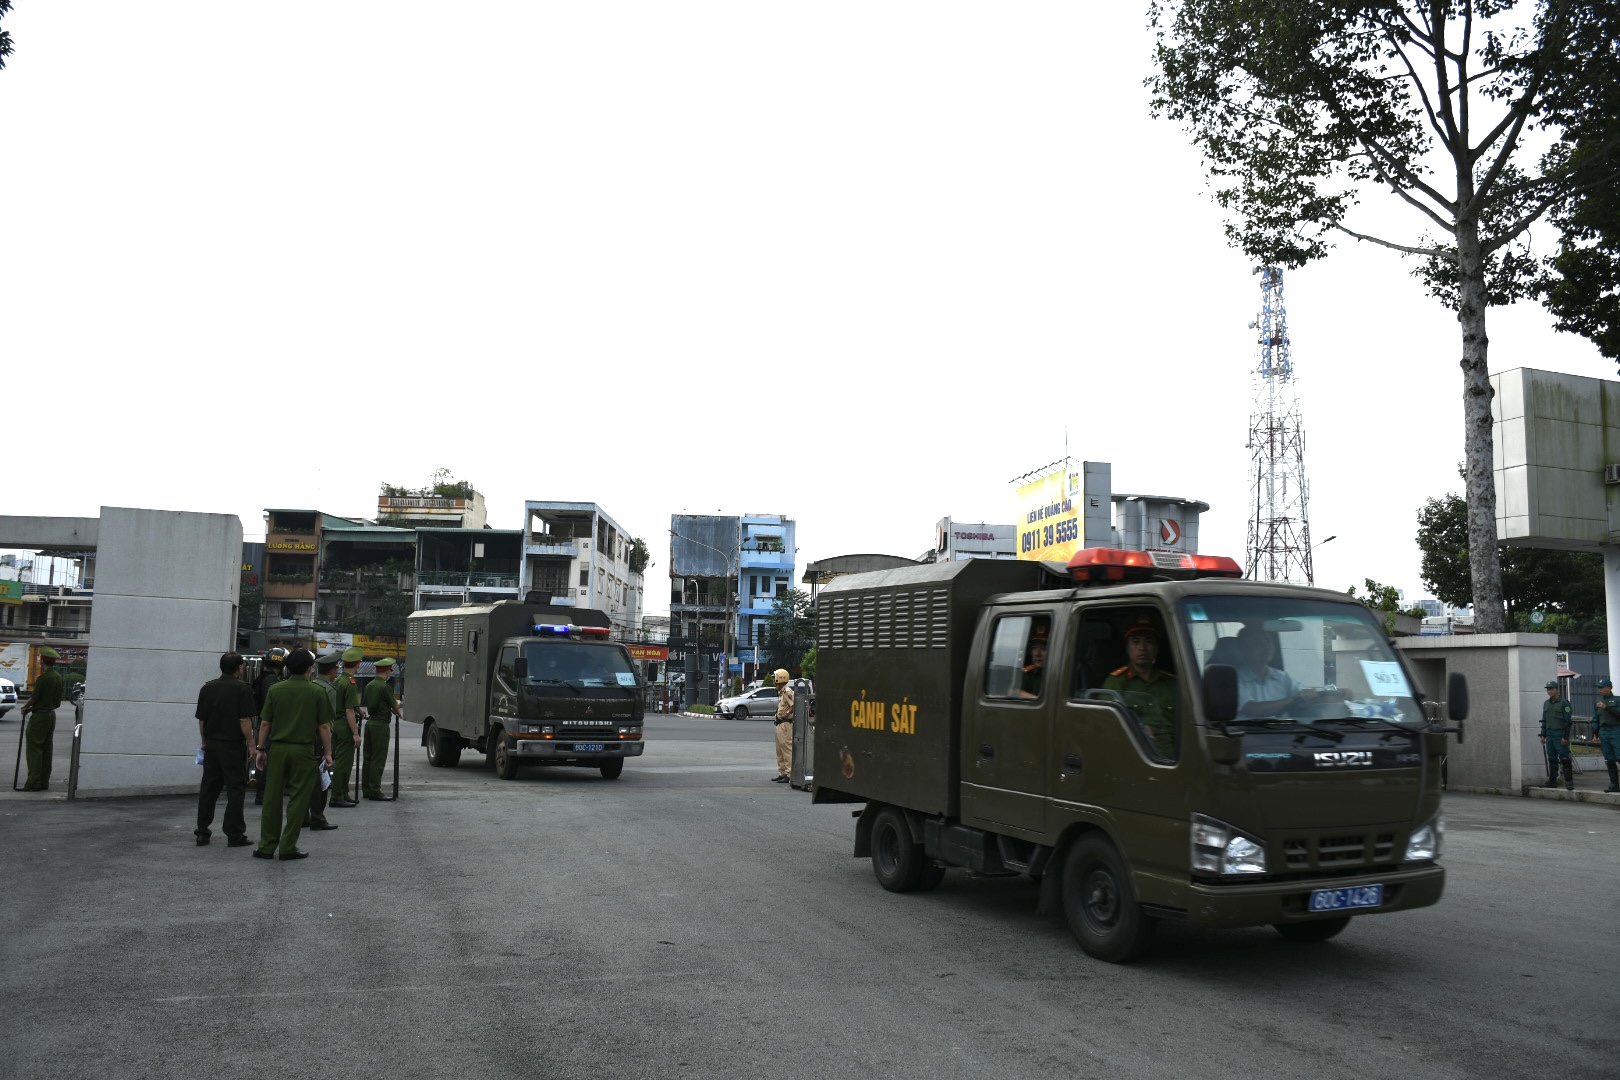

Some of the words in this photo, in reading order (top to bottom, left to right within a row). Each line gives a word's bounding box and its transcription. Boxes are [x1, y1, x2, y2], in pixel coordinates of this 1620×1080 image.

[1027, 509, 1037, 524] LIÊN
[1037, 506, 1044, 522] HỆ
[1045, 501, 1061, 519] QUẢNG
[1062, 497, 1072, 513] CÁO
[954, 531, 995, 541] TOSHIBA
[1022, 529, 1040, 553] 0911
[1043, 524, 1054, 547] 39
[1056, 517, 1078, 544] 5555
[443, 657, 454, 678] SÁT
[851, 688, 885, 731] CẢNH
[890, 696, 918, 734] SÁT
[1313, 751, 1373, 767] ISUZU
[1314, 887, 1379, 909] 60C-1426
